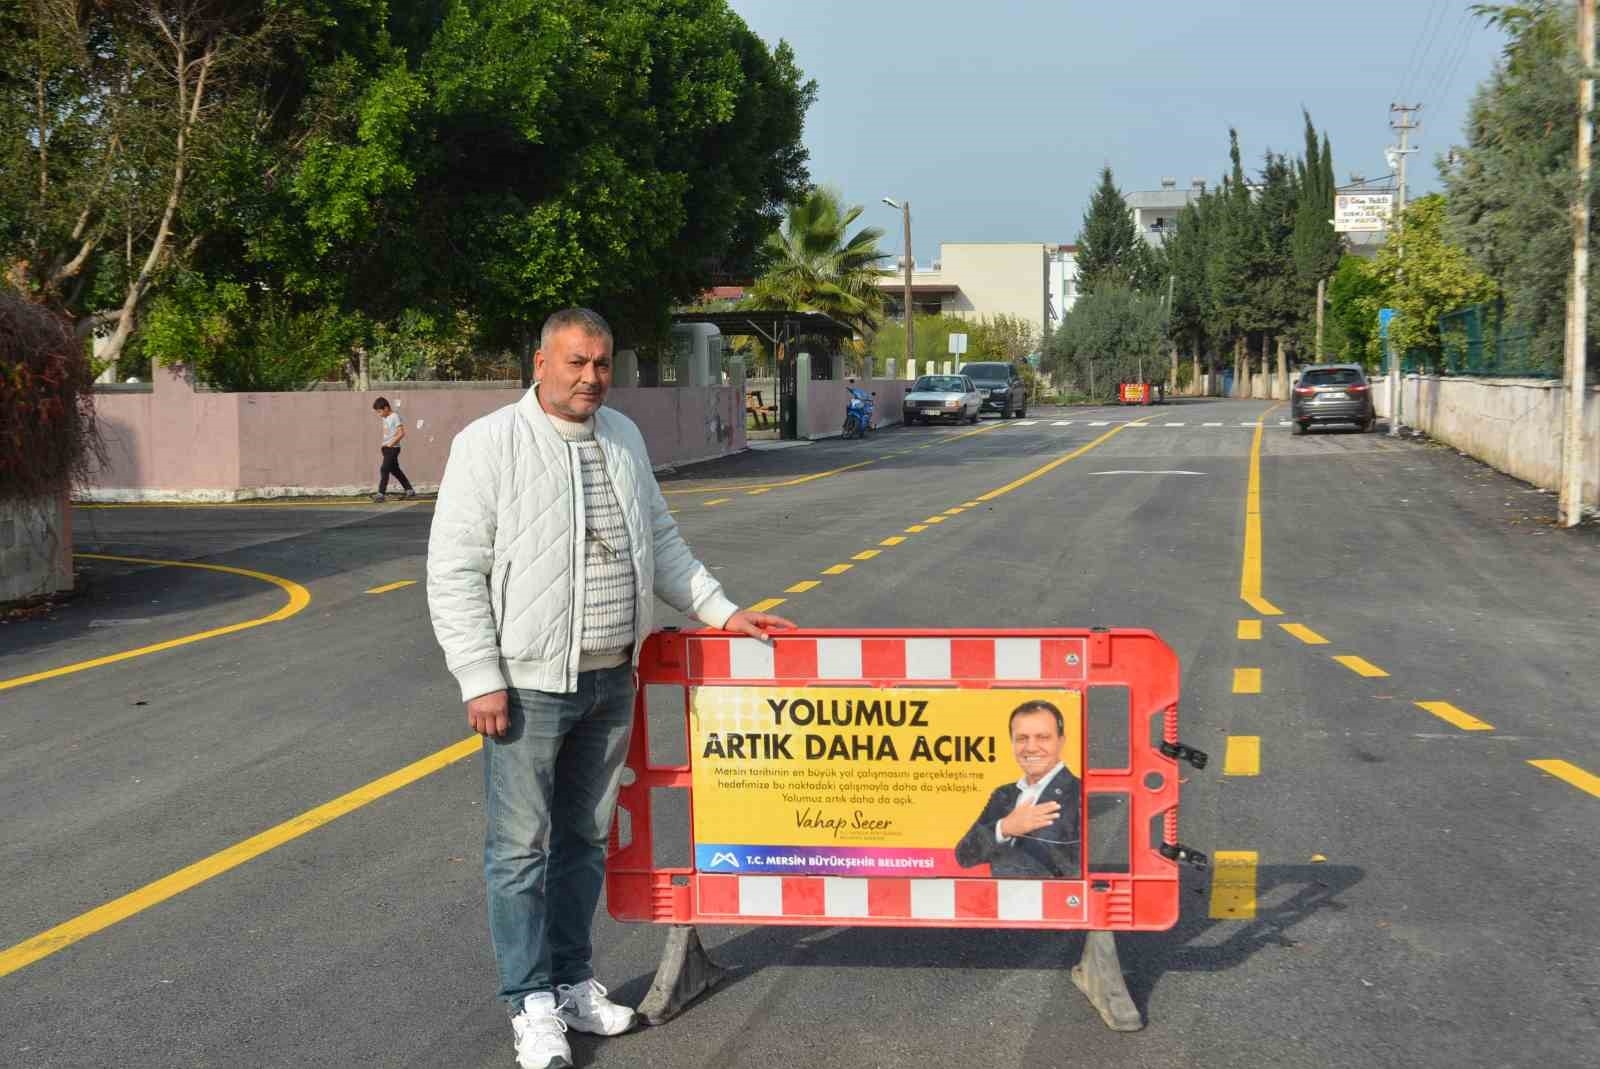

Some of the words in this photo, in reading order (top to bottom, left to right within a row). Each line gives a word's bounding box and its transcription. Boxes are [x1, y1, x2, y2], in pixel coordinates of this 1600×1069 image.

[767, 698, 929, 727] YOLUMUZ
[702, 732, 794, 760] ARTIK
[805, 734, 898, 761] DAHA
[910, 735, 996, 765] AÇIK!
[714, 767, 747, 776] Mersin
[749, 767, 790, 777] tarihinin
[792, 769, 805, 777] en
[807, 768, 837, 779] büyük
[839, 768, 854, 779] yol
[856, 768, 911, 780] çalışmasını
[718, 780, 770, 790] hedefimize
[772, 781, 785, 790] bu
[788, 781, 836, 791] noktadaki
[838, 781, 890, 793] çalışmayla
[891, 782, 918, 792] daha
[920, 782, 933, 792] da
[782, 793, 822, 803] Yolumuz
[825, 794, 847, 804] artık
[849, 795, 875, 804] daha
[878, 795, 891, 804] da
[796, 807, 847, 838] Vahap
[745, 855, 764, 865] T.C.
[766, 854, 806, 866] MERSİN
[808, 855, 876, 869] BÜYÜKŞEHİR
[877, 856, 935, 869] BELEDİYESİ
